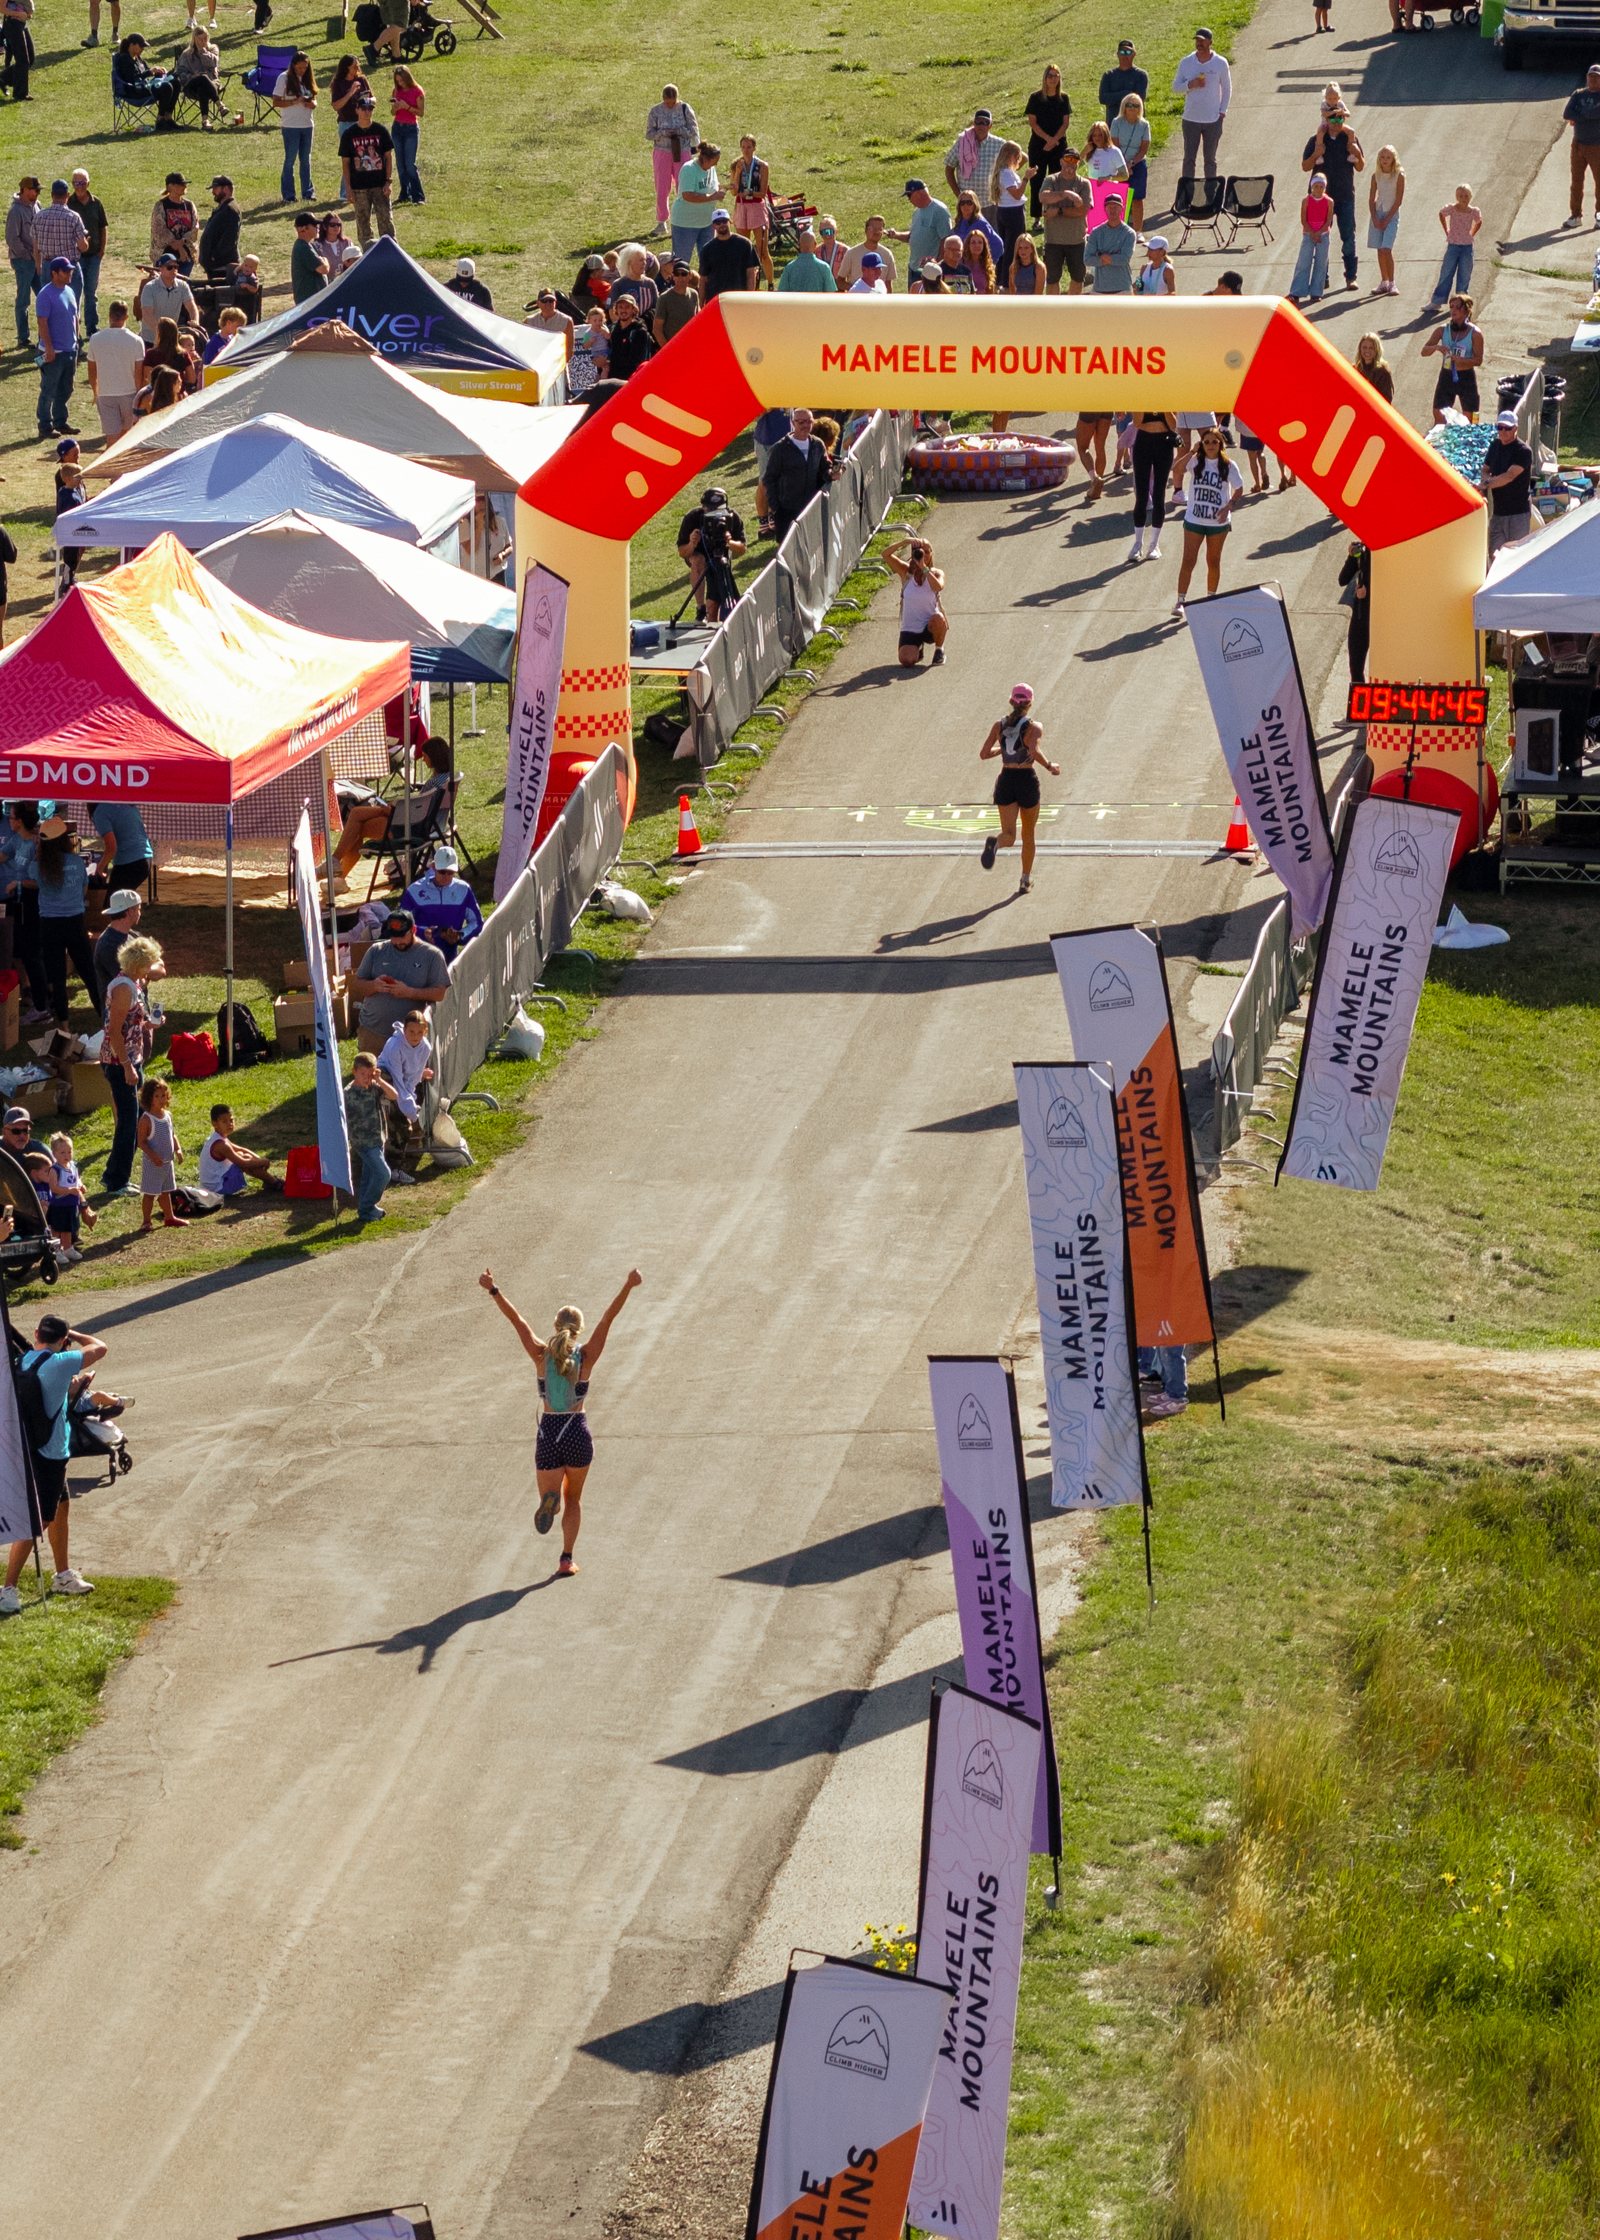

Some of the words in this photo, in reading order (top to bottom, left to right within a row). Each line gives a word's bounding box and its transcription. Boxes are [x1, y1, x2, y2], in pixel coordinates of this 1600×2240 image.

[370, 341, 447, 353] IOTICS
[460, 381, 487, 389] Silver
[489, 381, 522, 391] Strong
[822, 343, 957, 373] MAMELE
[971, 345, 1166, 375] MOUNTAINS
[1192, 503, 1219, 519] ONLY
[1350, 686, 1486, 724] 09:44:45
[1240, 733, 1286, 848] MAMELE
[1261, 704, 1313, 864] MOUNTAINS
[1329, 942, 1375, 1065] MAMELE
[1350, 924, 1408, 1097] MOUNTAINS
[1116, 1096, 1147, 1228] MAMELE
[1130, 1066, 1176, 1250] MOUNTAINS
[1055, 1241, 1089, 1379] MAMELE
[1077, 1213, 1109, 1410] MOUNTAINS
[972, 1539, 1004, 1693] MAMELE
[938, 1890, 970, 2063] MAMELE
[959, 1871, 1000, 2113] MOUNTAINS
[828, 2055, 852, 2067] CLIMB
[854, 2063, 883, 2076] HIGHER
